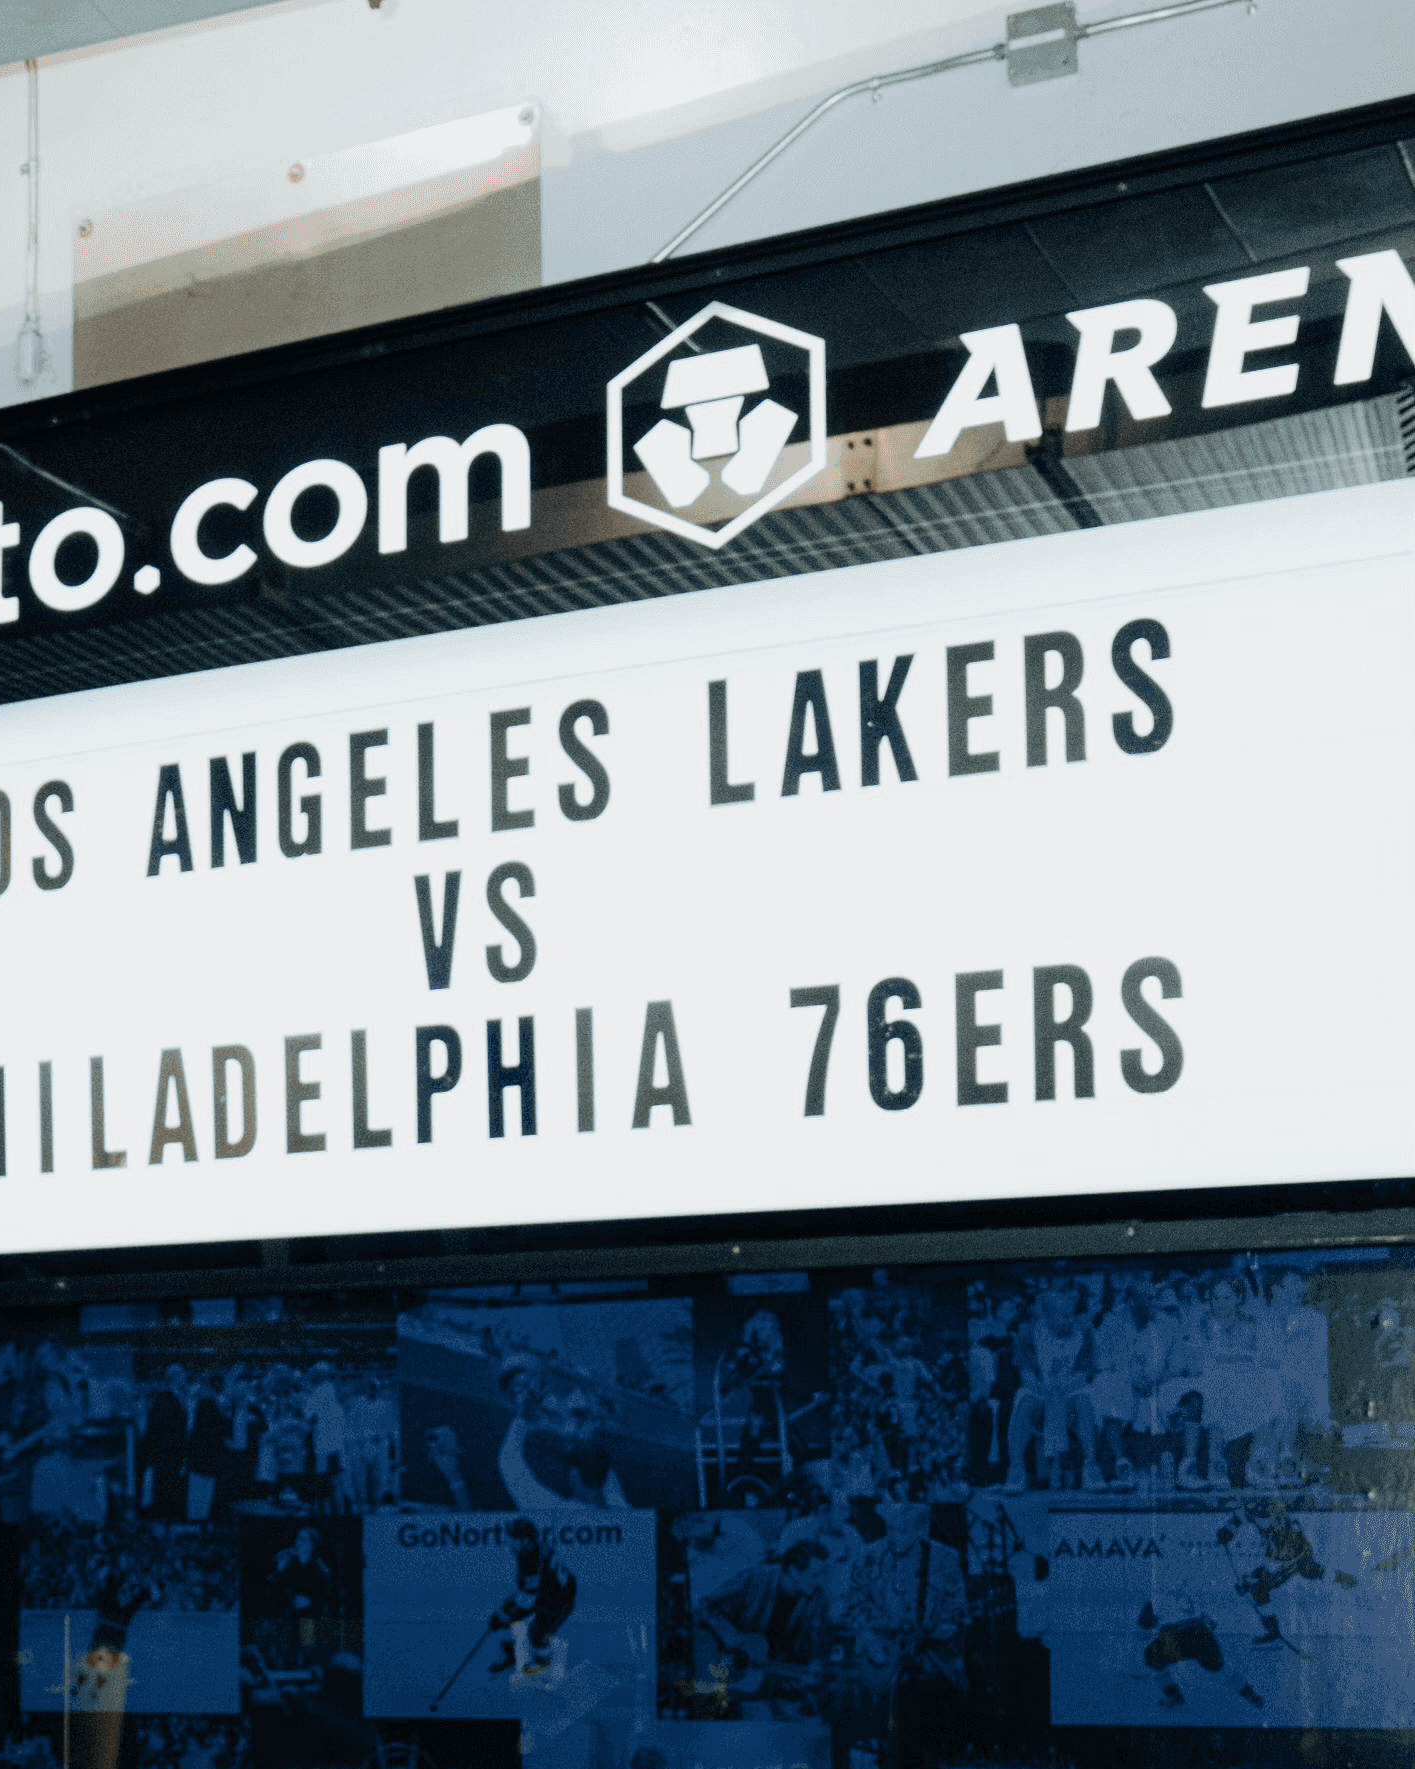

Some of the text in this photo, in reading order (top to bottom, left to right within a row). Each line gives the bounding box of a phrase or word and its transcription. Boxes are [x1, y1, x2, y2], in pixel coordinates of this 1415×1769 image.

[145, 698, 611, 878] ANGELES
[707, 617, 1175, 807] LAKERS
[413, 861, 537, 992] VS
[789, 956, 1184, 1118] 76ERS
